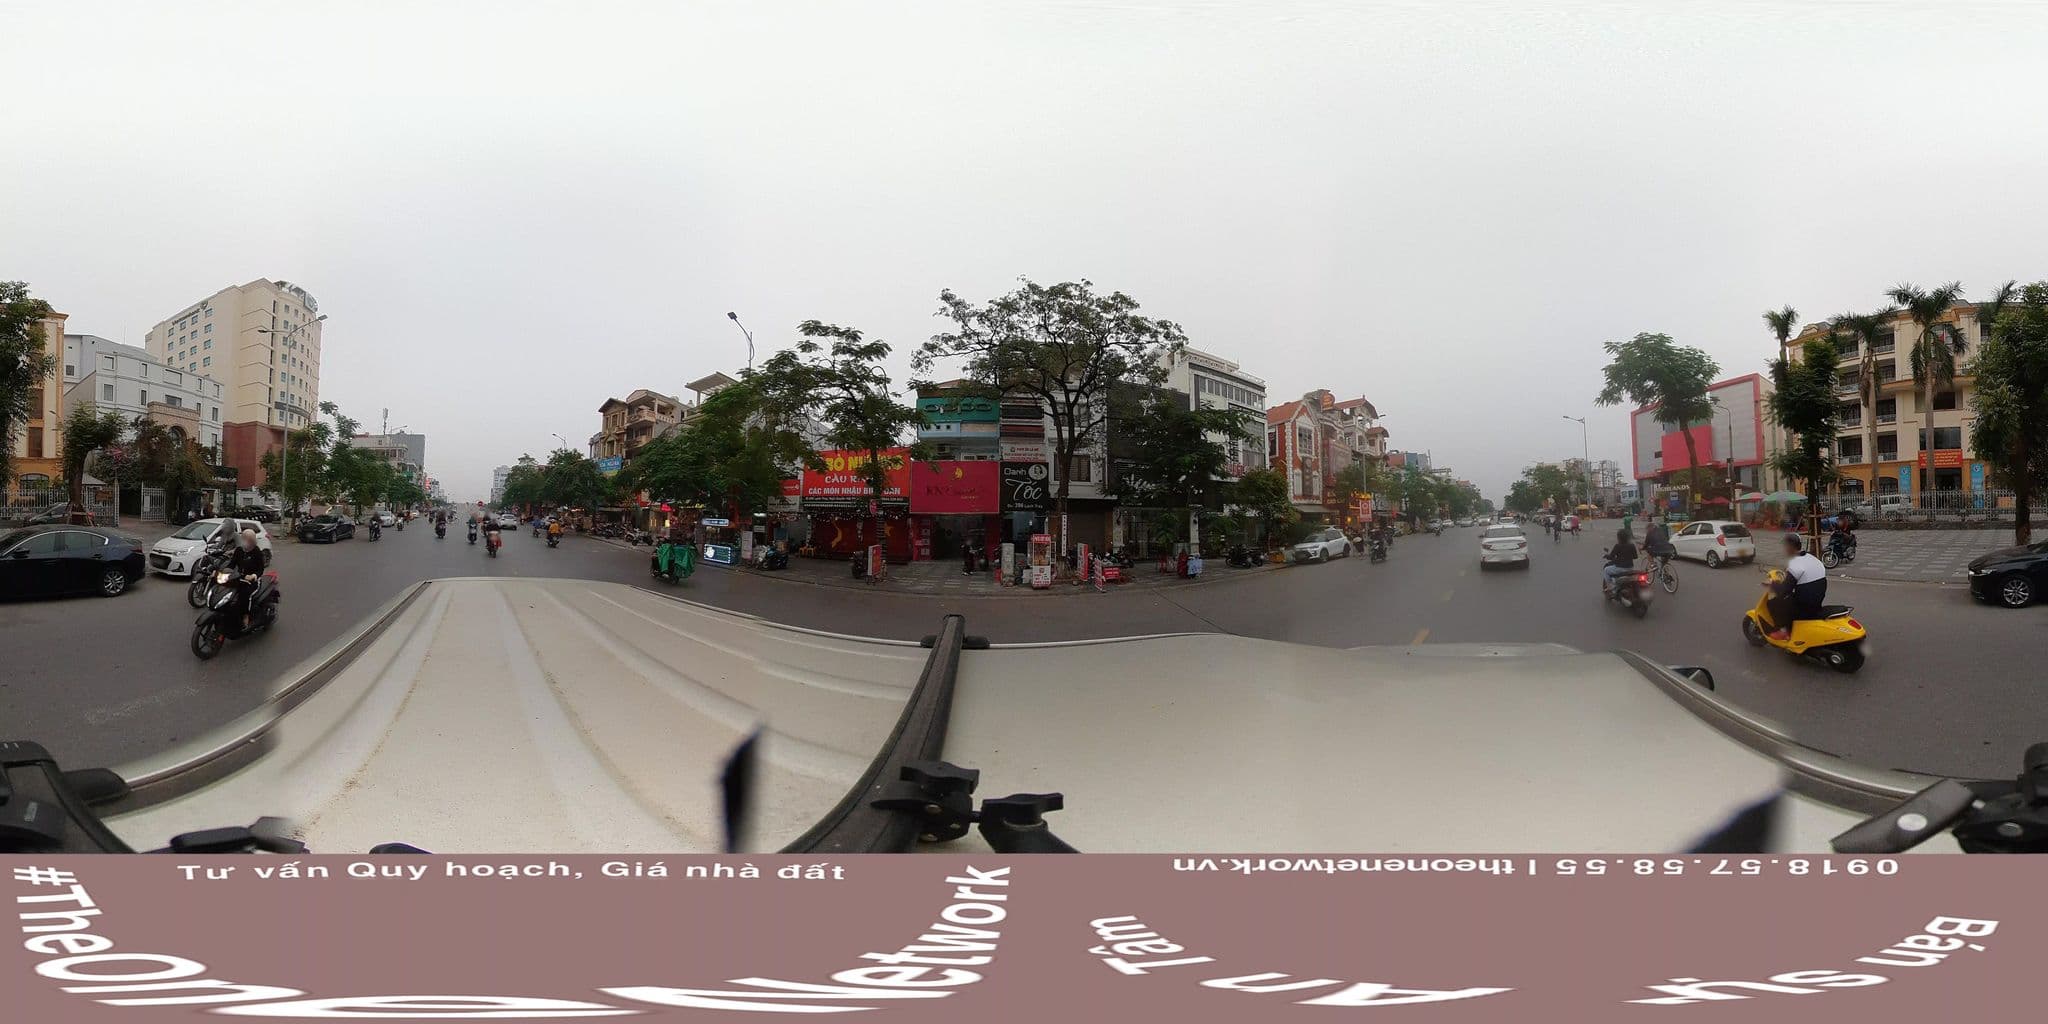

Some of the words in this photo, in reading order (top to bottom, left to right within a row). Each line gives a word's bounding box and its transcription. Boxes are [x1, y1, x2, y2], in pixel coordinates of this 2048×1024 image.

[823, 486, 840, 495] MÓN
[841, 486, 862, 496] NHẬU
[1005, 478, 1043, 501] Tóc
